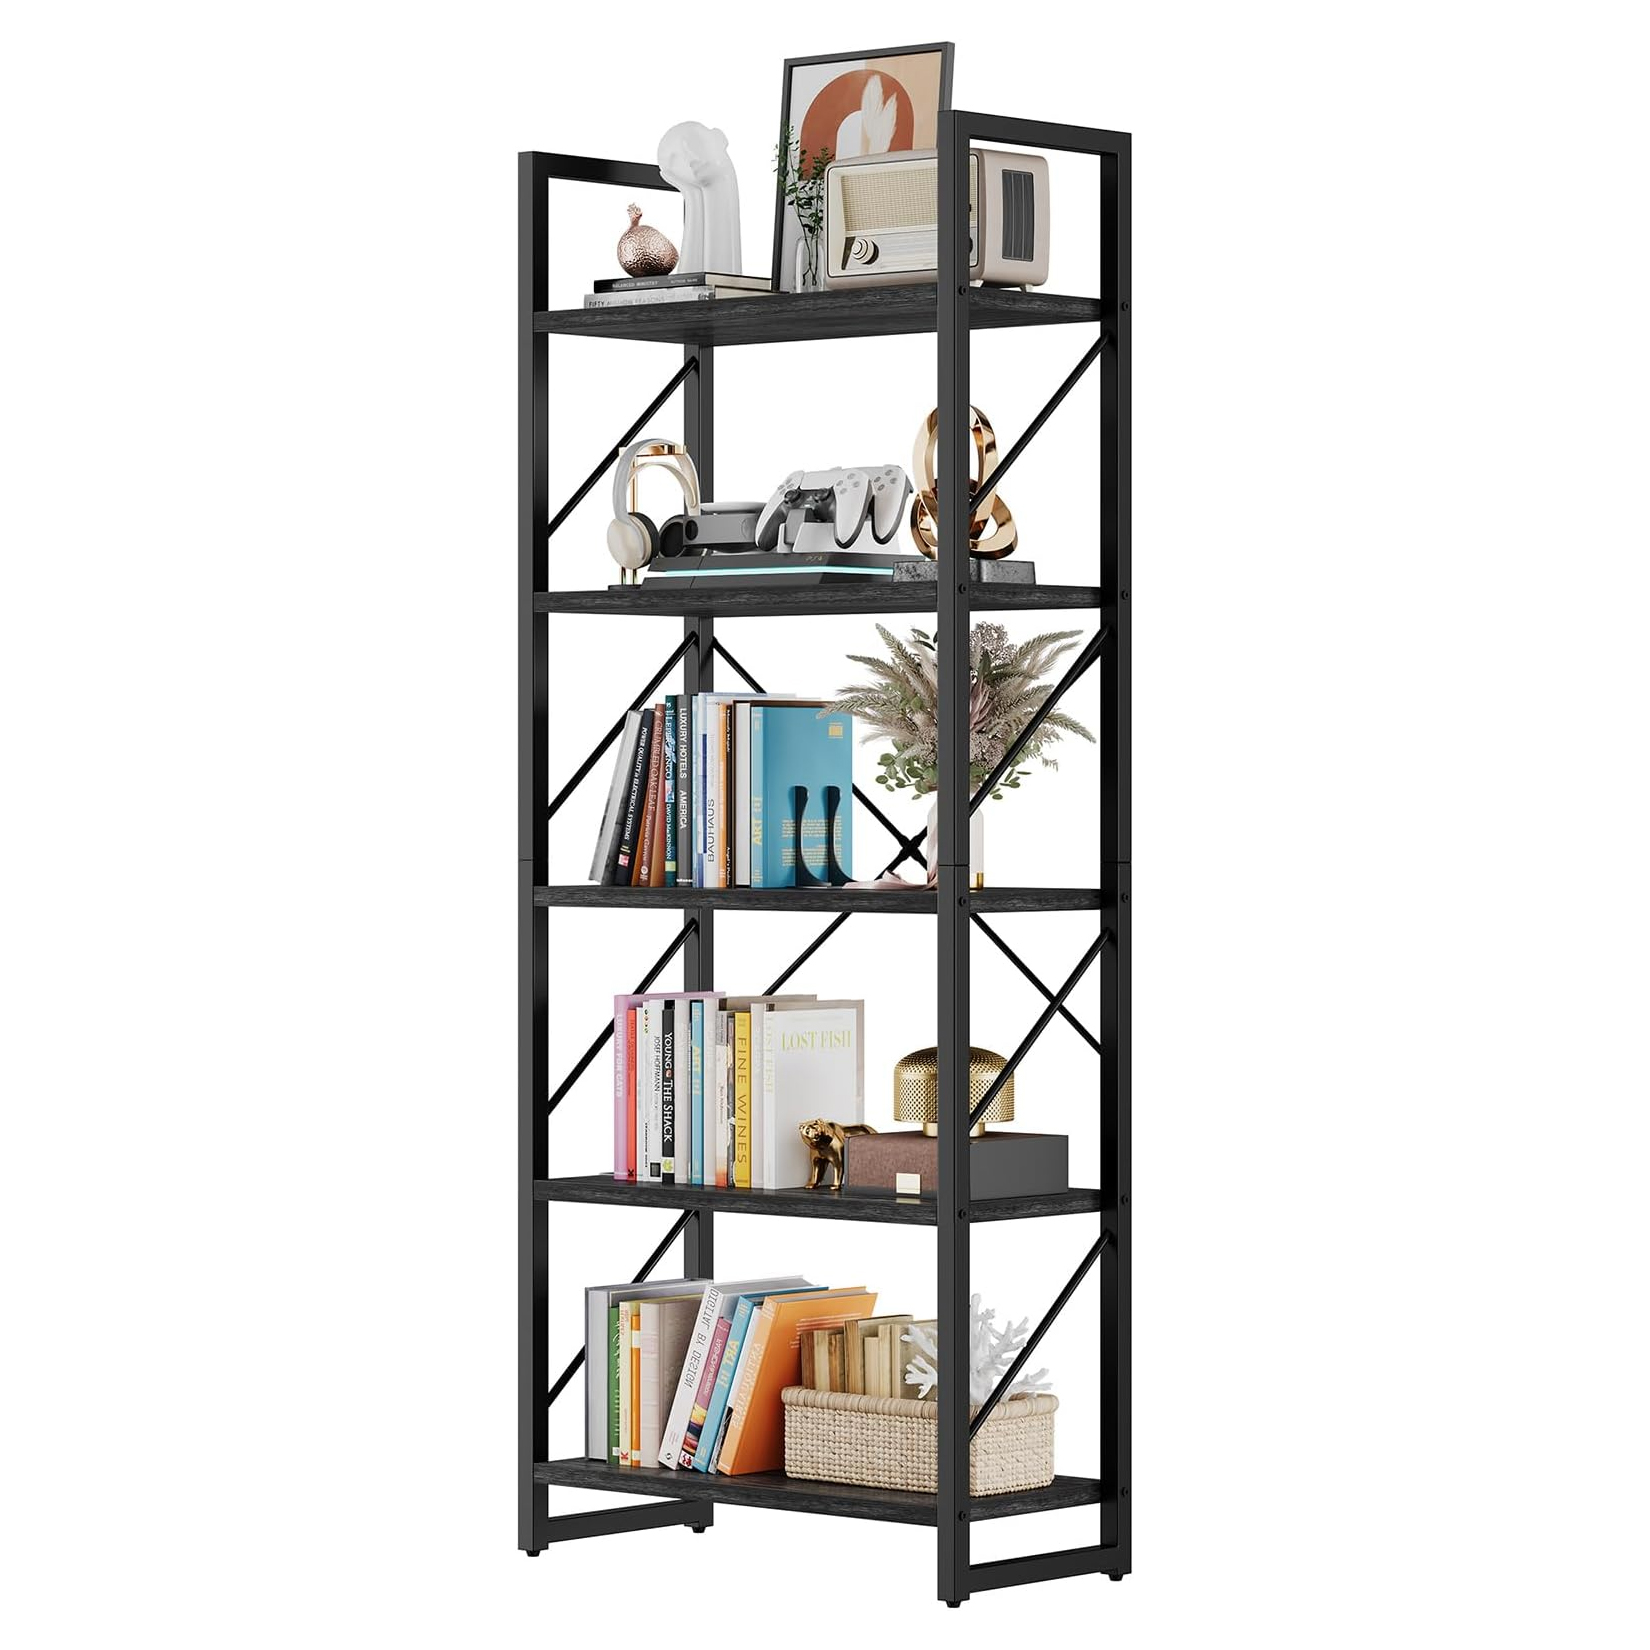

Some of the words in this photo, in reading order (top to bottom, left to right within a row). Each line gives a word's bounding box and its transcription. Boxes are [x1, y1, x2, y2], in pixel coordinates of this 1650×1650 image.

[640, 727, 648, 746] POWER
[651, 720, 662, 767] CRUMBLED
[629, 777, 639, 812] ELECTRICAL
[649, 767, 658, 787] OAK
[624, 813, 633, 840] SYSTEMS
[664, 1032, 673, 1069] YOUNG
[781, 1030, 818, 1050] LOST
[820, 1030, 852, 1049] FISH
[737, 1038, 747, 1084] FINE
[663, 1079, 673, 1102] THE
[663, 1104, 673, 1142] SHACK
[737, 1094, 747, 1164] WINES
